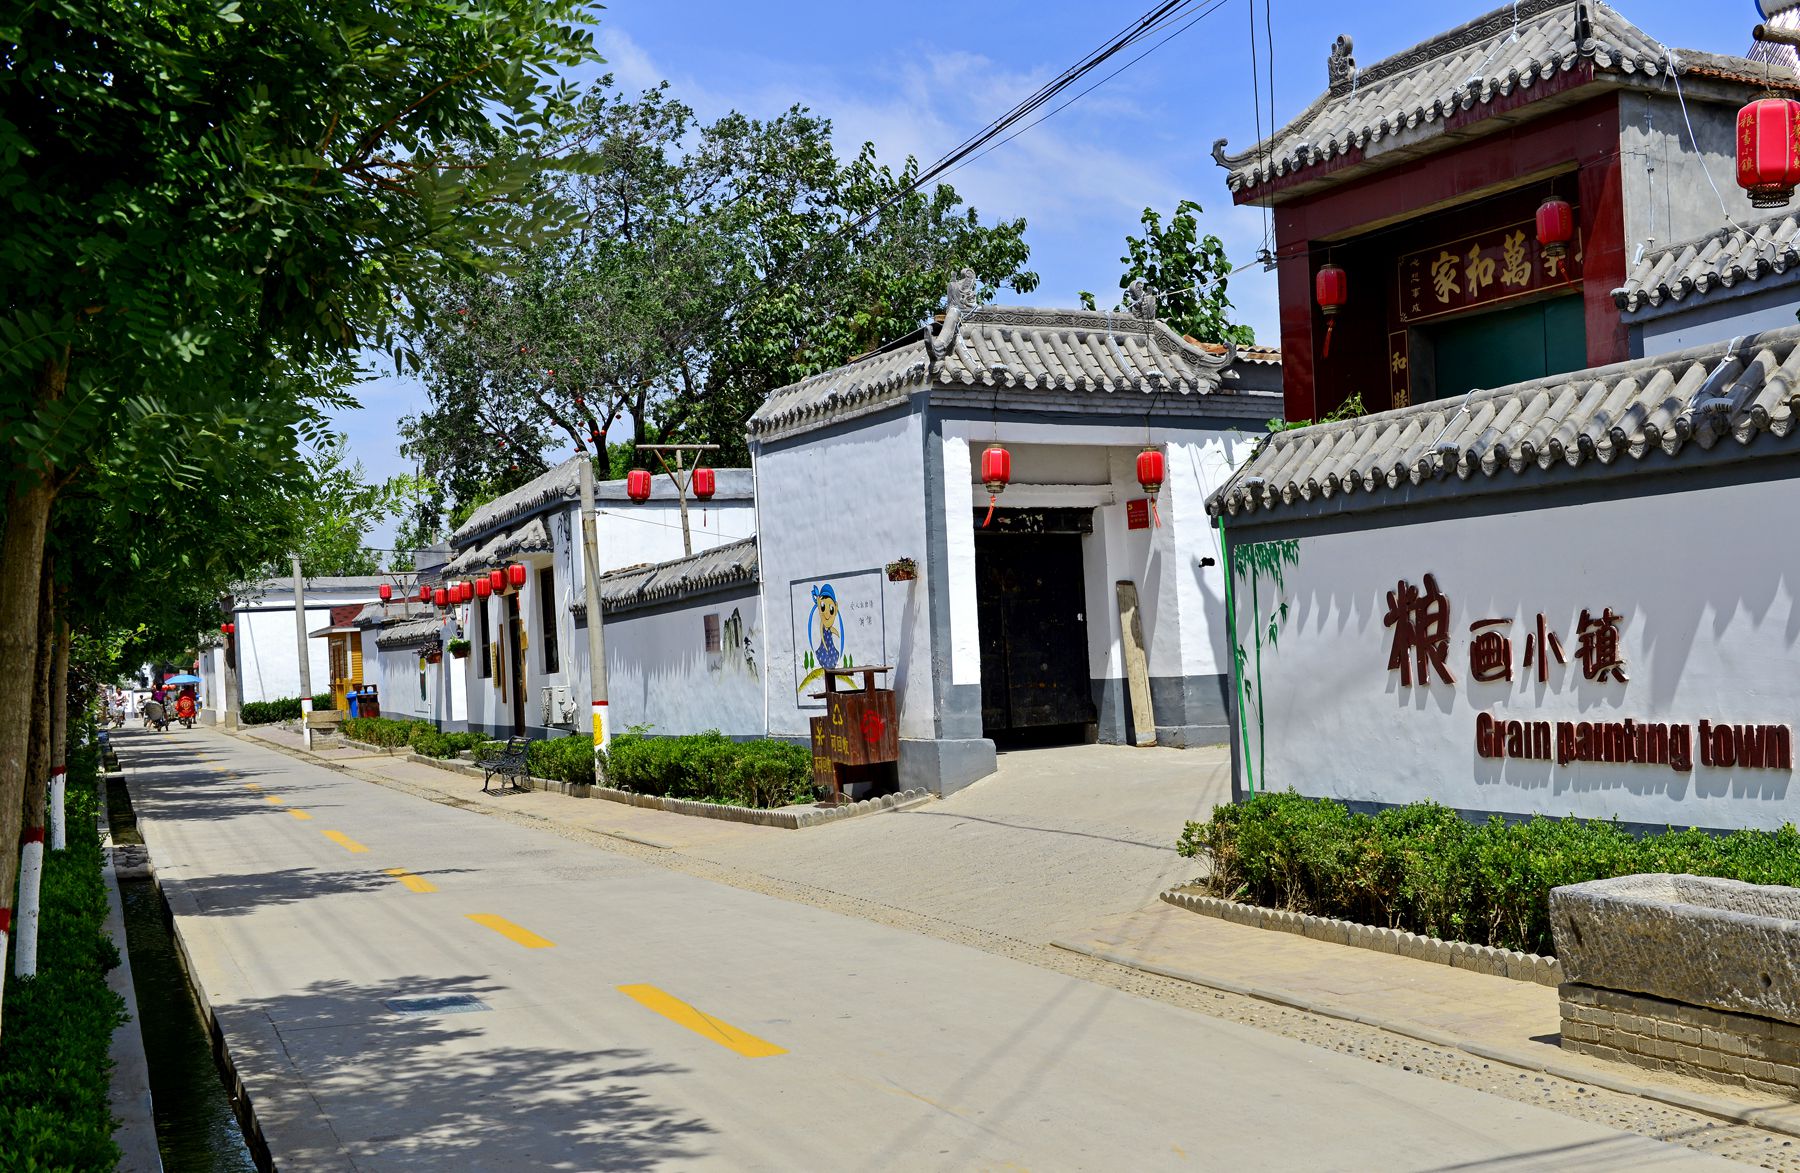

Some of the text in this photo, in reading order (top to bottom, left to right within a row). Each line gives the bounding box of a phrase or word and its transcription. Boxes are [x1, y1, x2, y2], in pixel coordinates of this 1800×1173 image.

[1383, 572, 1630, 687] 粮画小镇
[1475, 710, 1794, 773] Grain painting town
